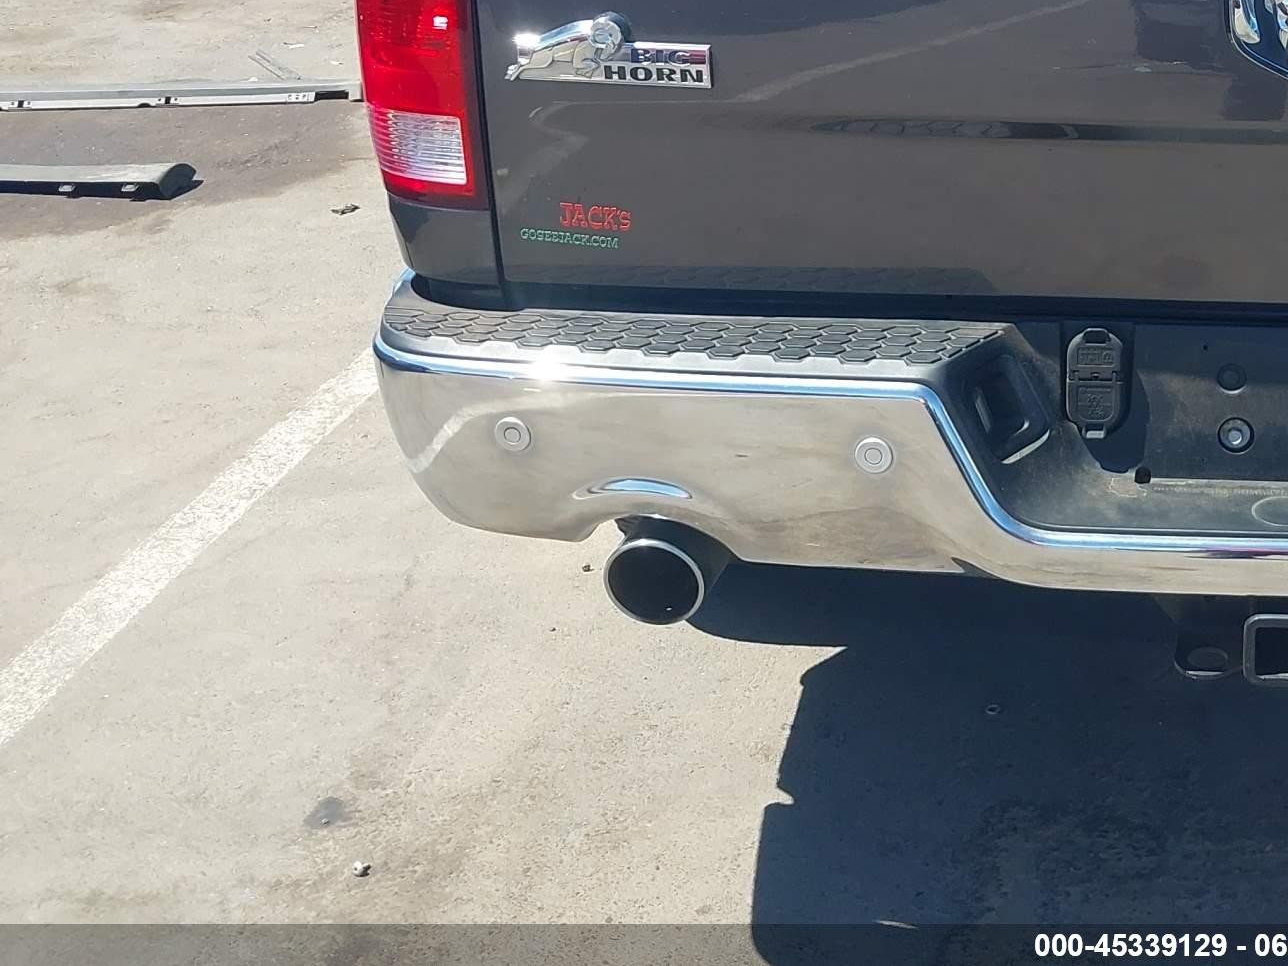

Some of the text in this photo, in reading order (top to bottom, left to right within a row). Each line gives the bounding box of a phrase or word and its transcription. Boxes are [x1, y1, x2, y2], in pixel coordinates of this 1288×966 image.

[630, 49, 692, 66] BIG
[603, 65, 705, 83] HORN
[520, 228, 619, 248] GOSEEJACK.COM
